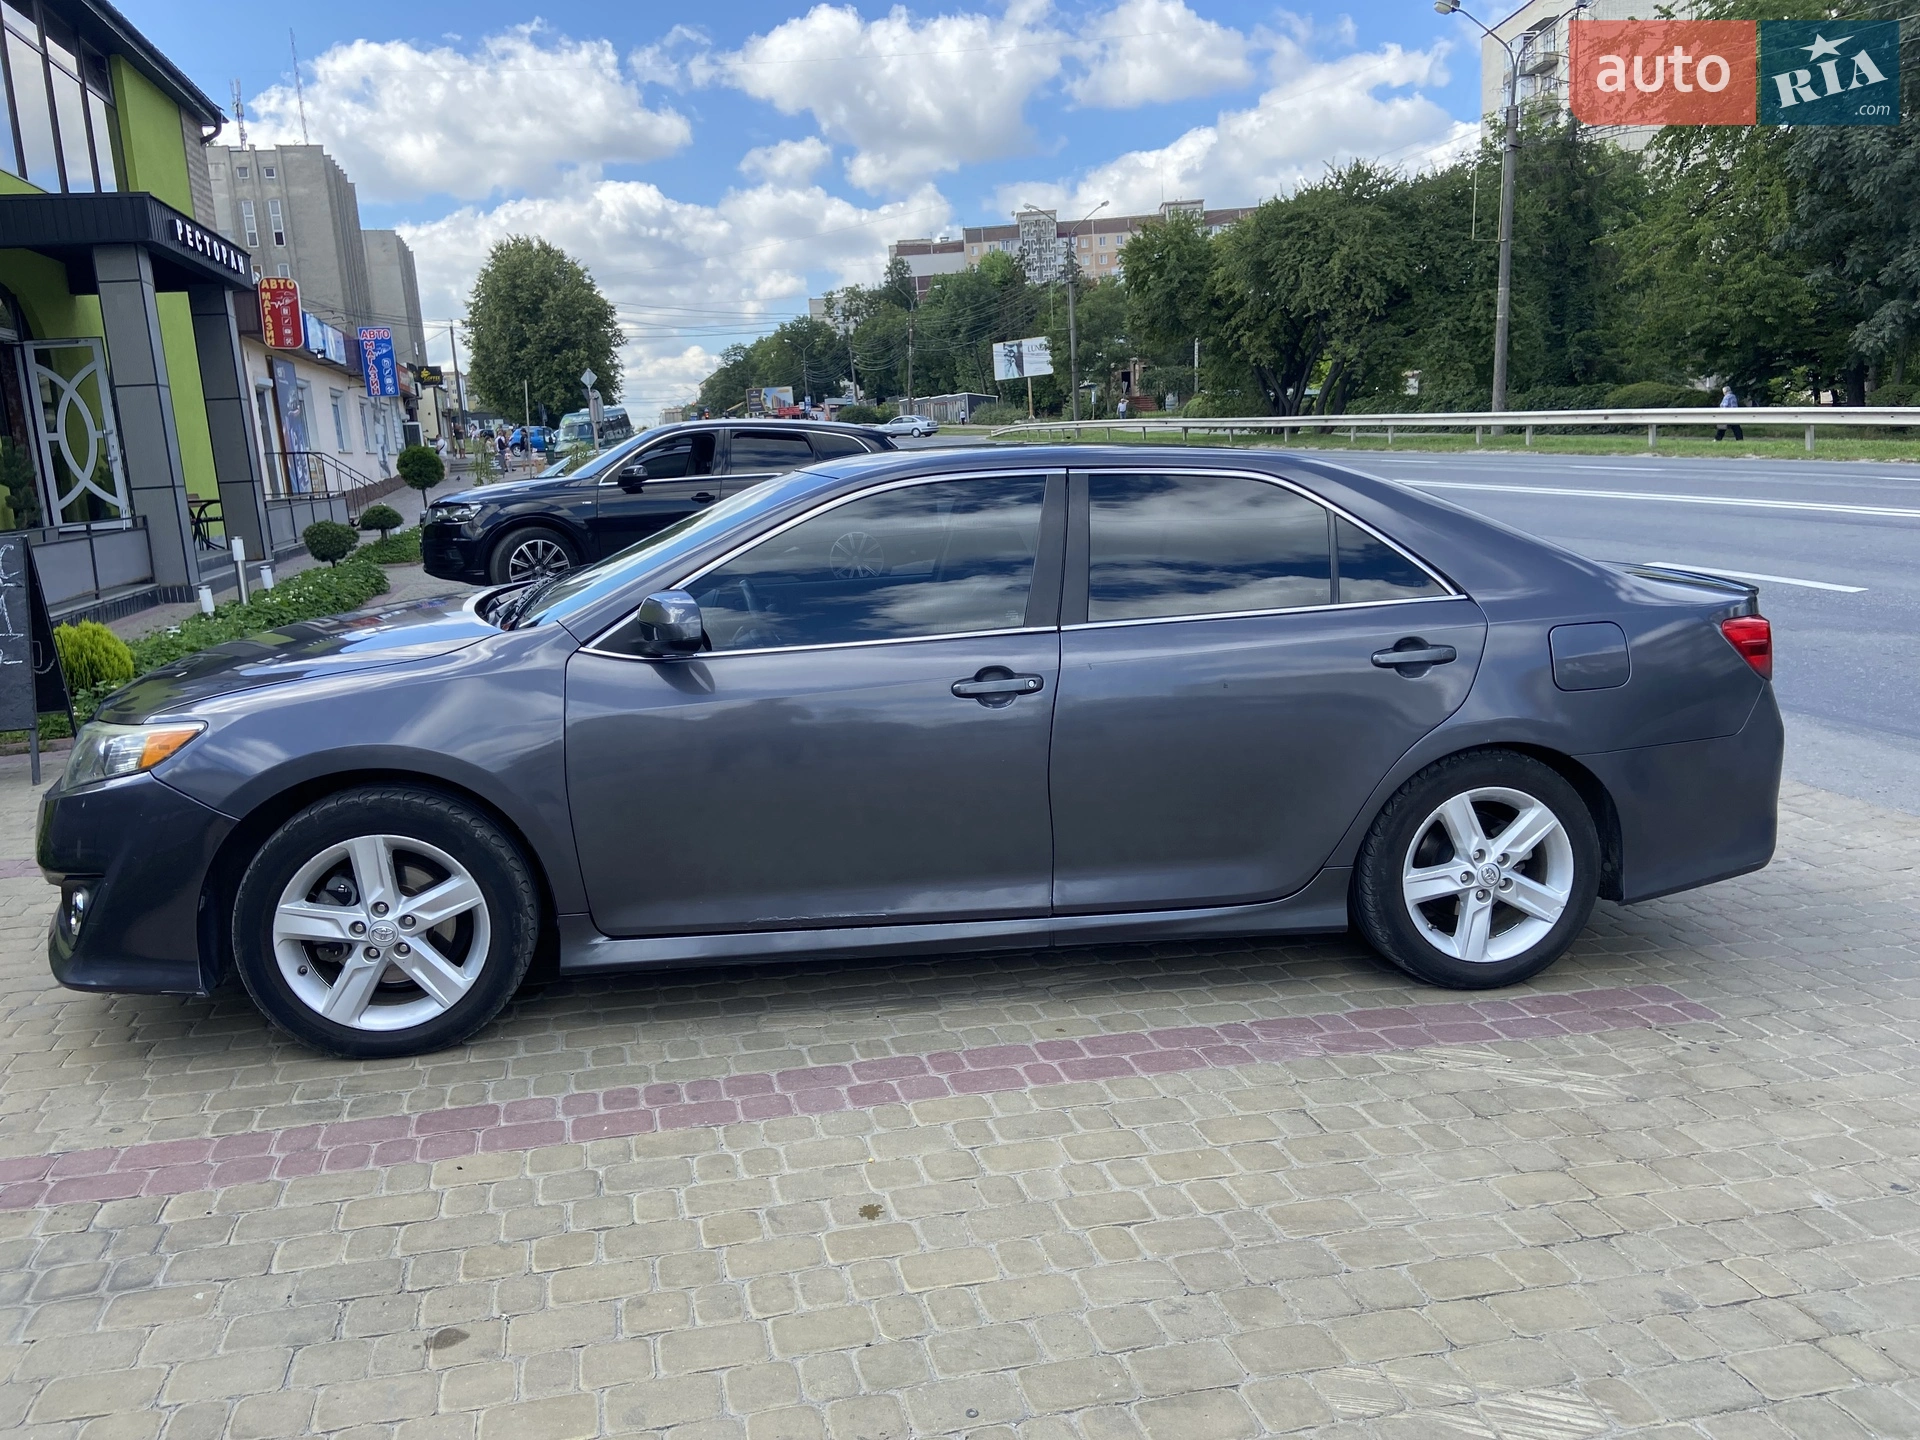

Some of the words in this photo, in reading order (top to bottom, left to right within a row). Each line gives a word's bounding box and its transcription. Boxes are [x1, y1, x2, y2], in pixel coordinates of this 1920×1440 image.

[175, 218, 245, 275] РЕСТОРАН
[261, 279, 295, 290] АВТО
[261, 291, 276, 346] МАГАЗИН
[360, 328, 392, 340] АВТО
[363, 340, 381, 396] МАГАЗИН
